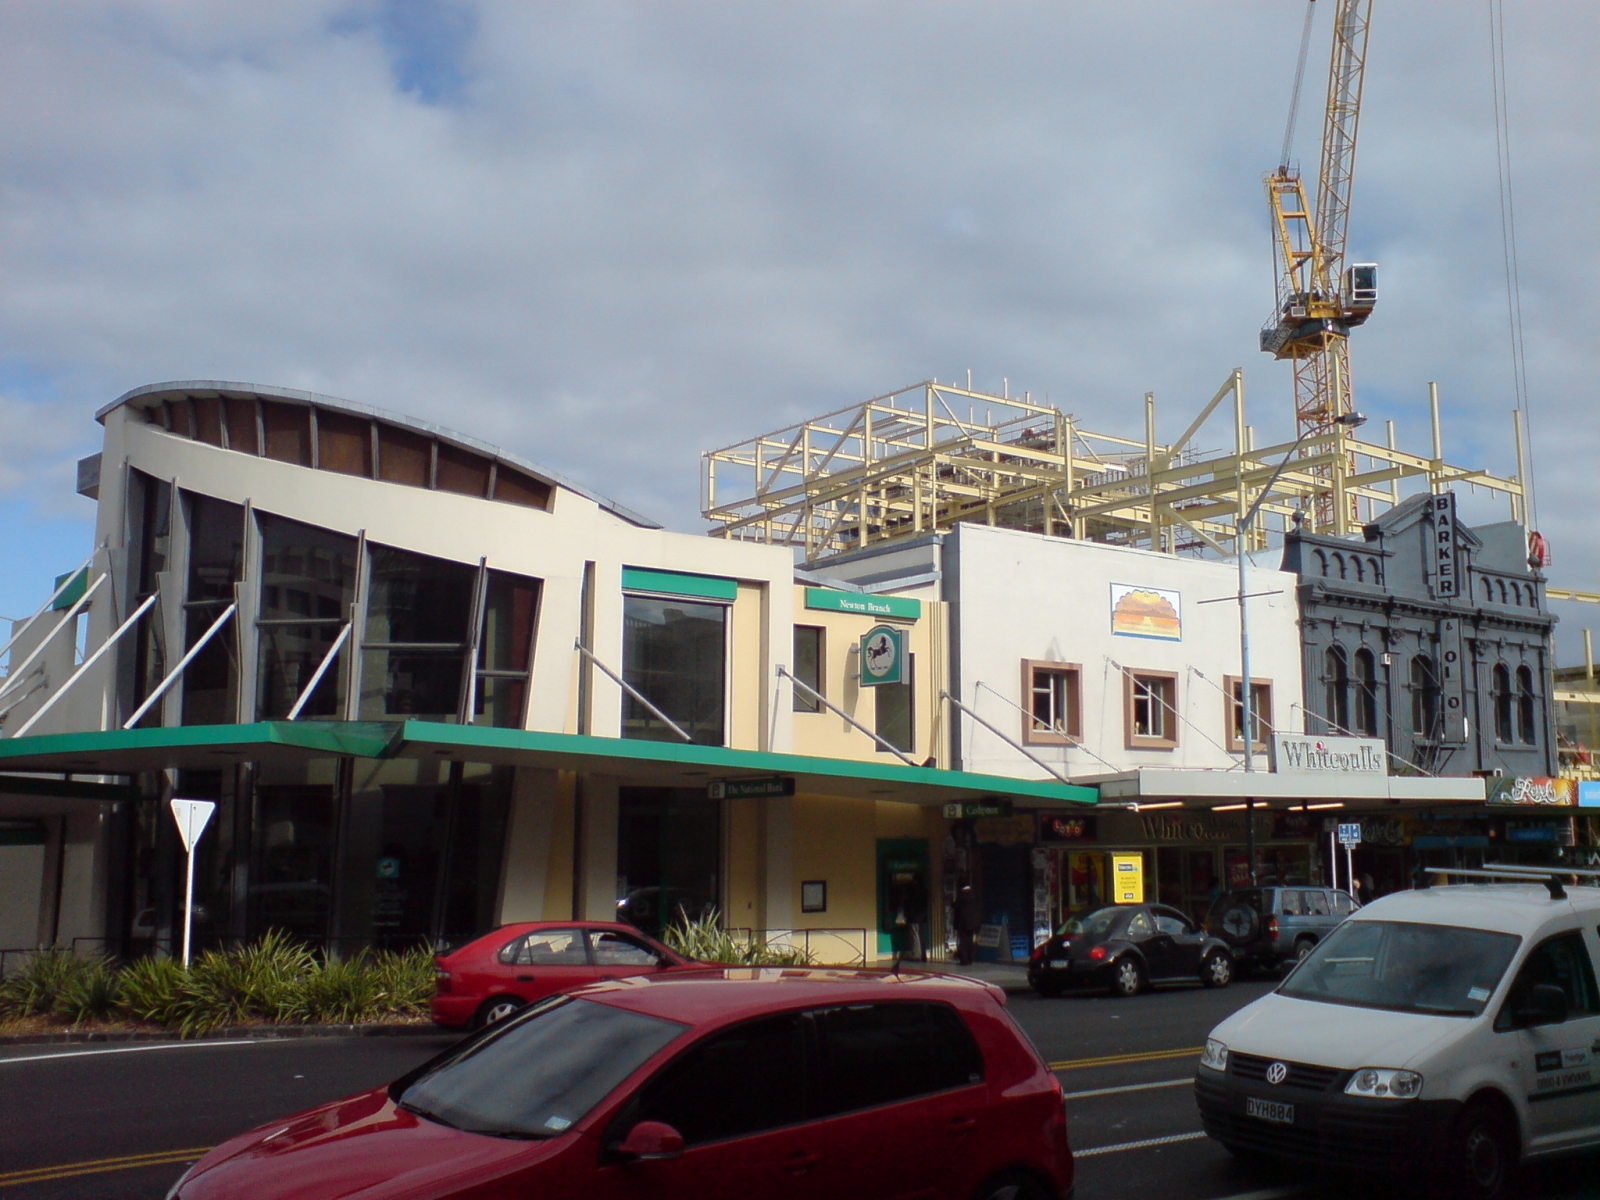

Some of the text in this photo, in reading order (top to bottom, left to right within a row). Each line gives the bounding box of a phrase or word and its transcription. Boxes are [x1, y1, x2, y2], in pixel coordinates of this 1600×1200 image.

[1436, 497, 1453, 593] BARKER
[840, 599, 891, 613] Newton Branch
[1282, 741, 1382, 771] Whitcoulls
[728, 782, 783, 794] The National Bank
